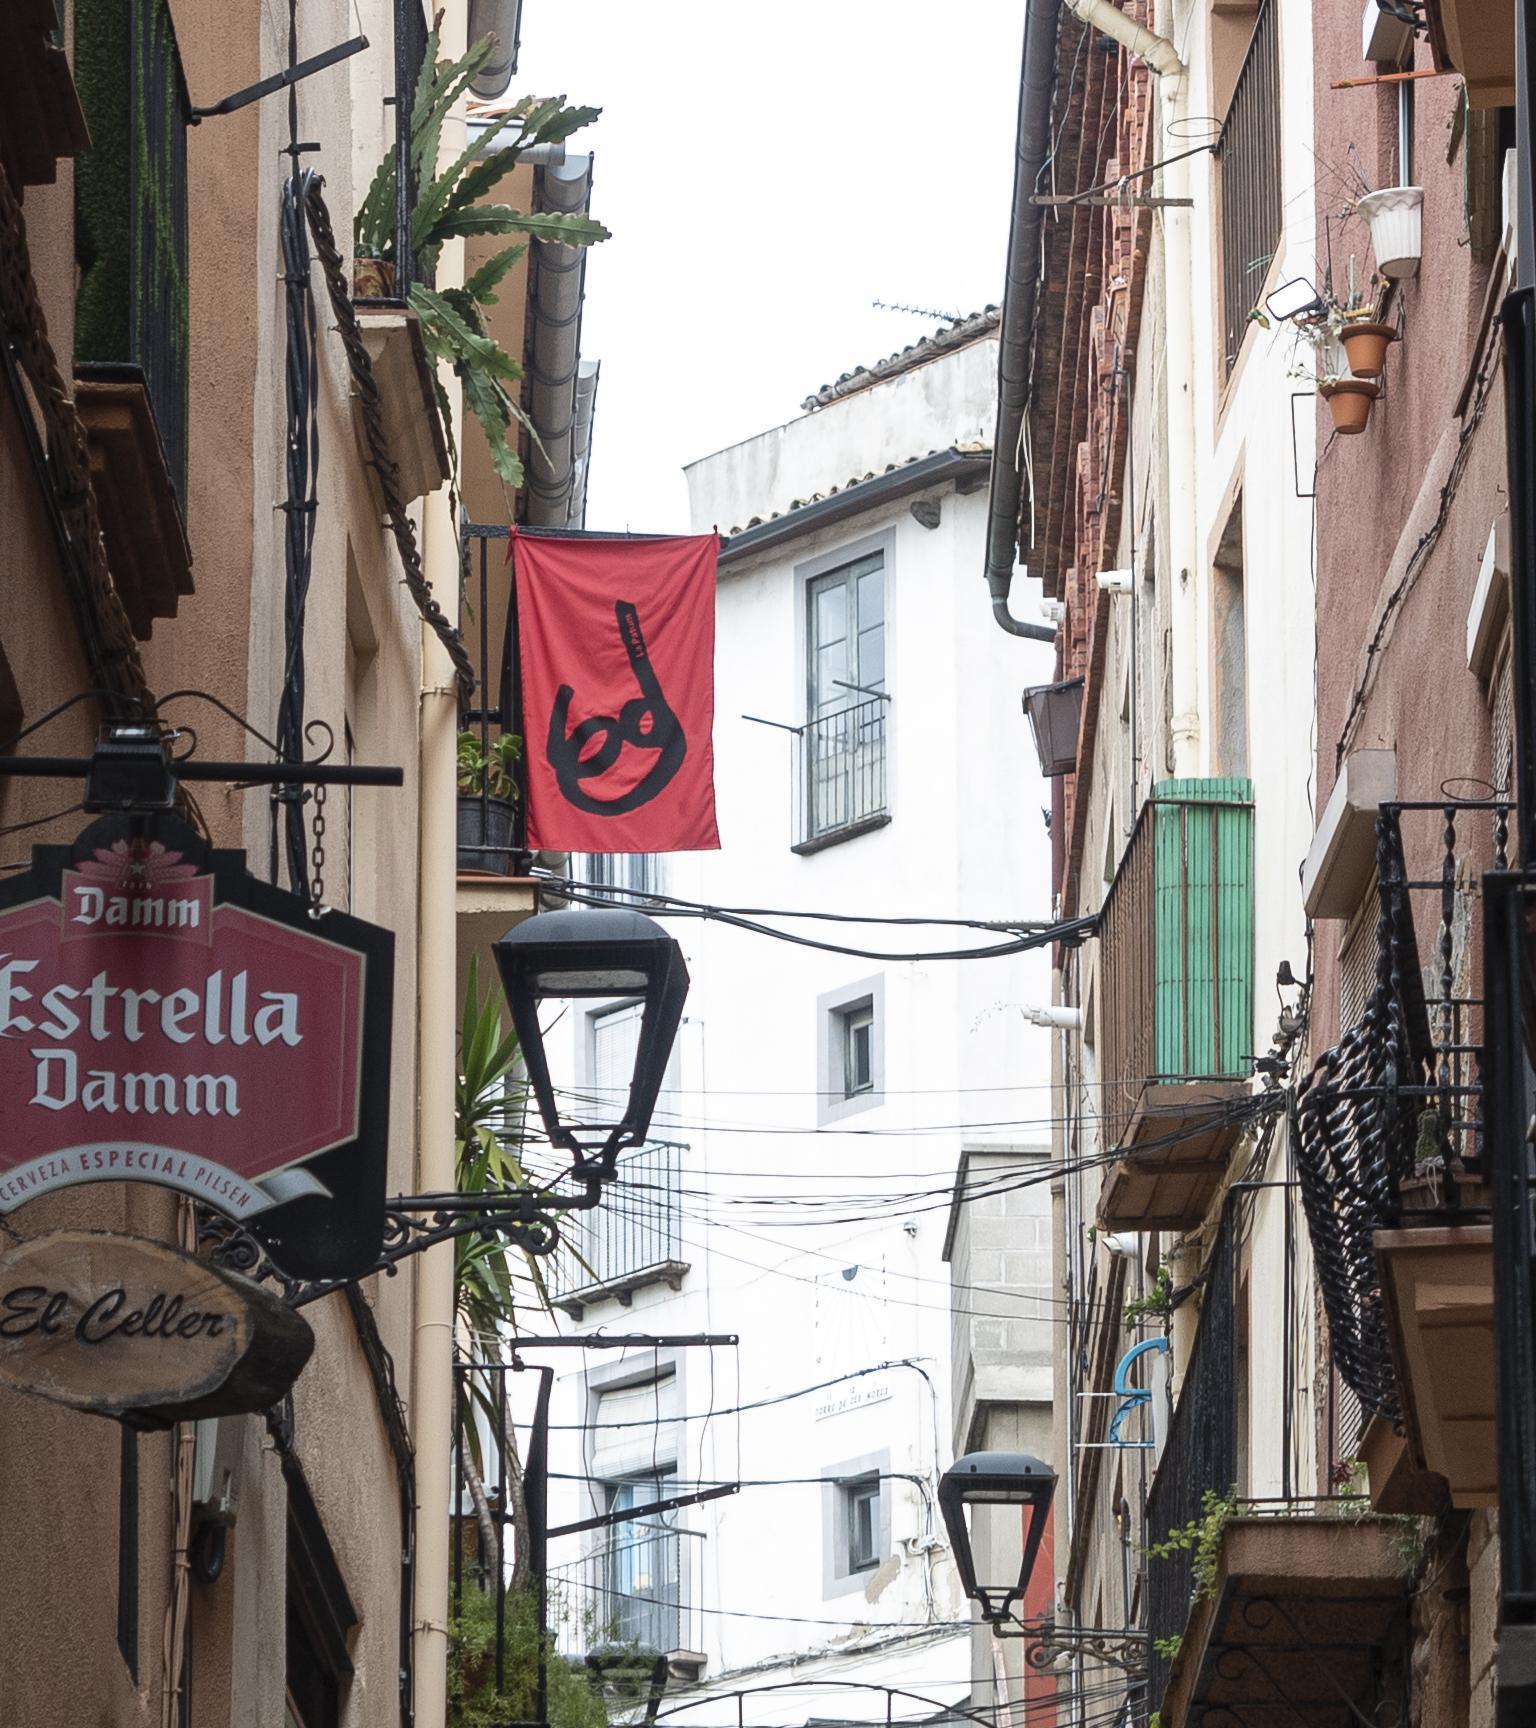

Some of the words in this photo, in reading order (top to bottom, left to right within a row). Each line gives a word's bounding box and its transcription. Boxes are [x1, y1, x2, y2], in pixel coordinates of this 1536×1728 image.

[72, 885, 200, 928] Damm
[28, 1047, 241, 1117] Damm
[80, 1150, 189, 1178] ESPECIAL
[195, 1167, 251, 1208] PILSEN
[75, 1288, 224, 1344] Celler
